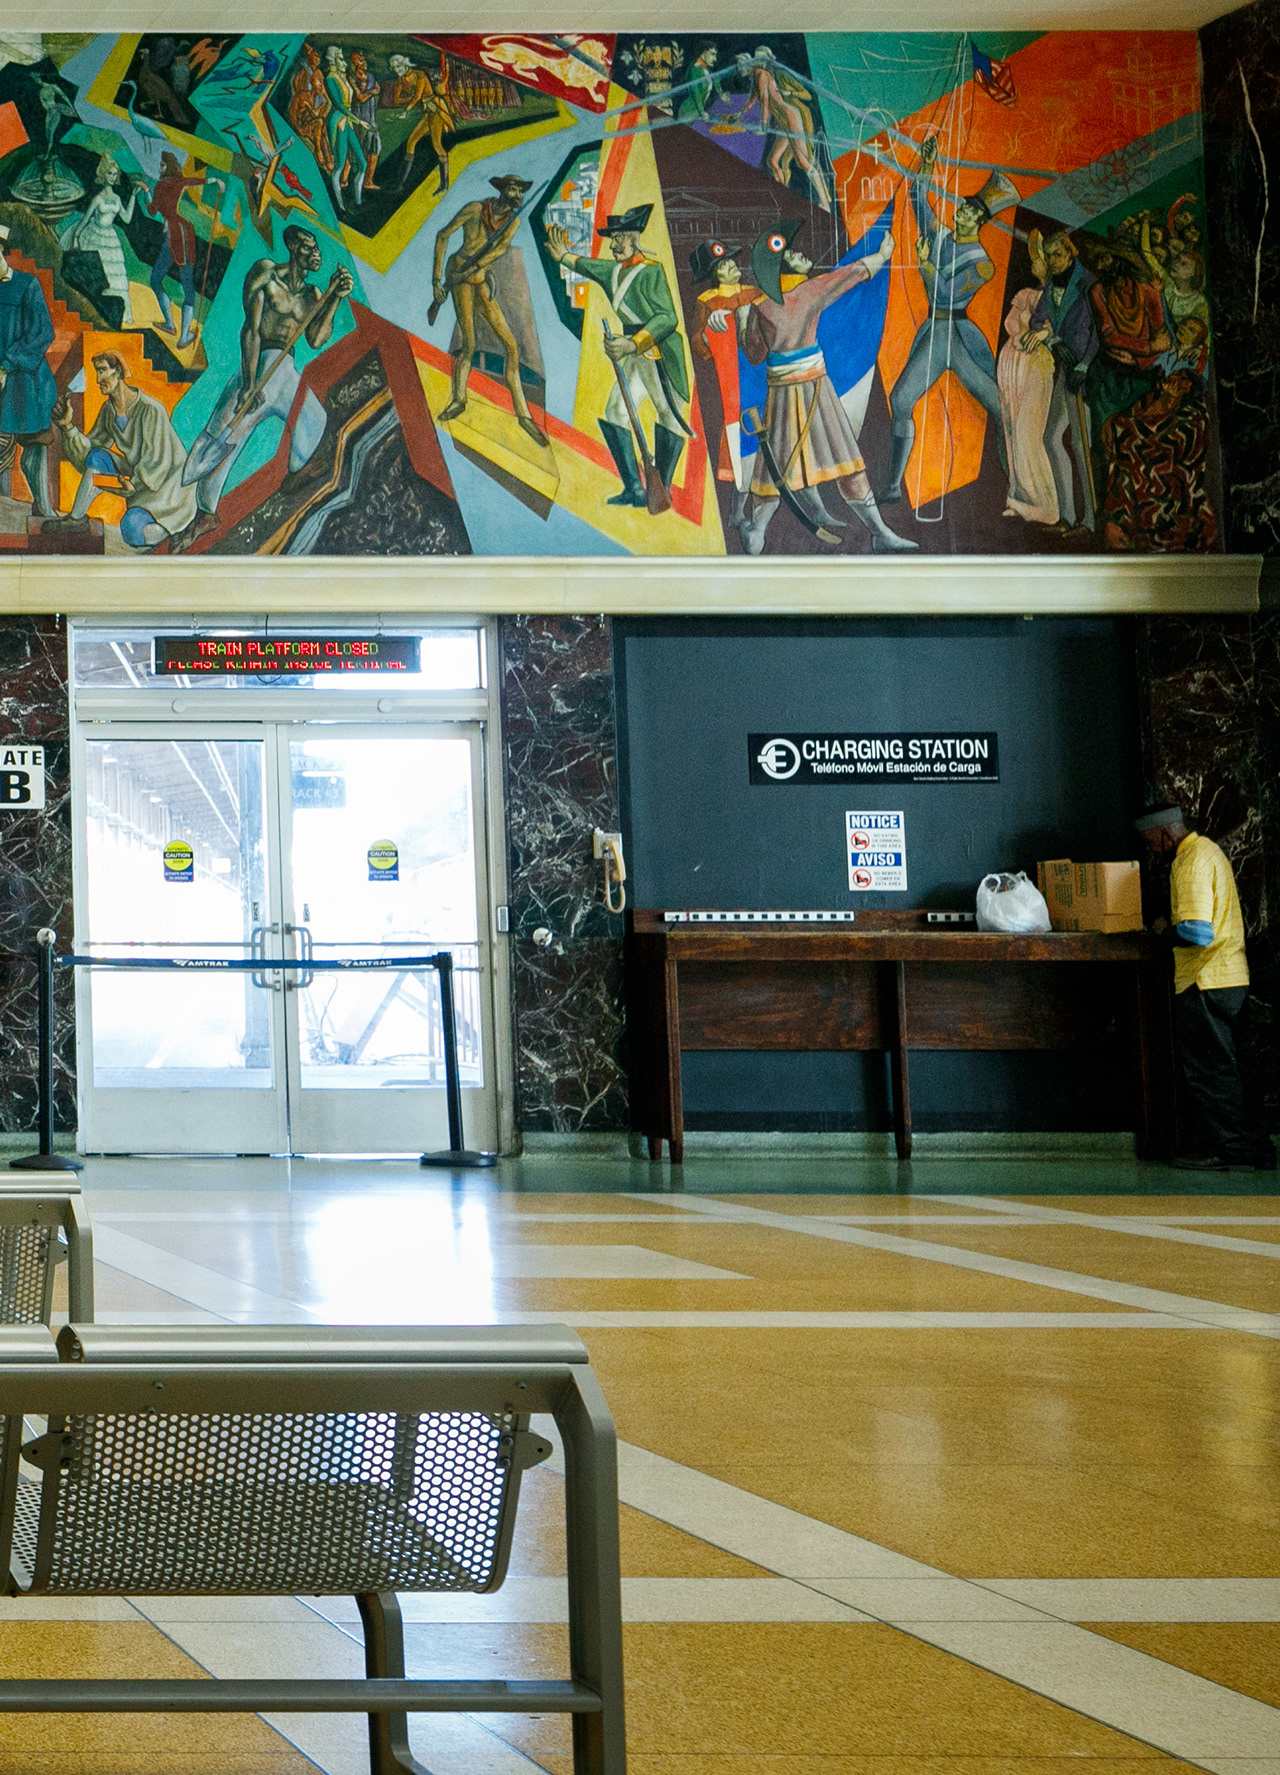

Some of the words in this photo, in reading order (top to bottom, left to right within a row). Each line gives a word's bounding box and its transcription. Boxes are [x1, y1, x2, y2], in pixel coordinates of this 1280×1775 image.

[197, 642, 242, 655] TRAIN
[247, 642, 320, 655] PLATFORM
[324, 642, 379, 655] CLOSED
[802, 739, 904, 760] CHARGING
[908, 739, 989, 759] STATION
[811, 762, 855, 774] Teléfono
[857, 761, 884, 773] Móvil
[886, 761, 931, 773] Estación
[933, 761, 947, 773] de
[949, 761, 982, 775] Carga
[0, 770, 31, 804] B
[851, 815, 899, 828] NOTICE
[857, 853, 896, 866] AVISO
[352, 959, 393, 967] AMTRAK
